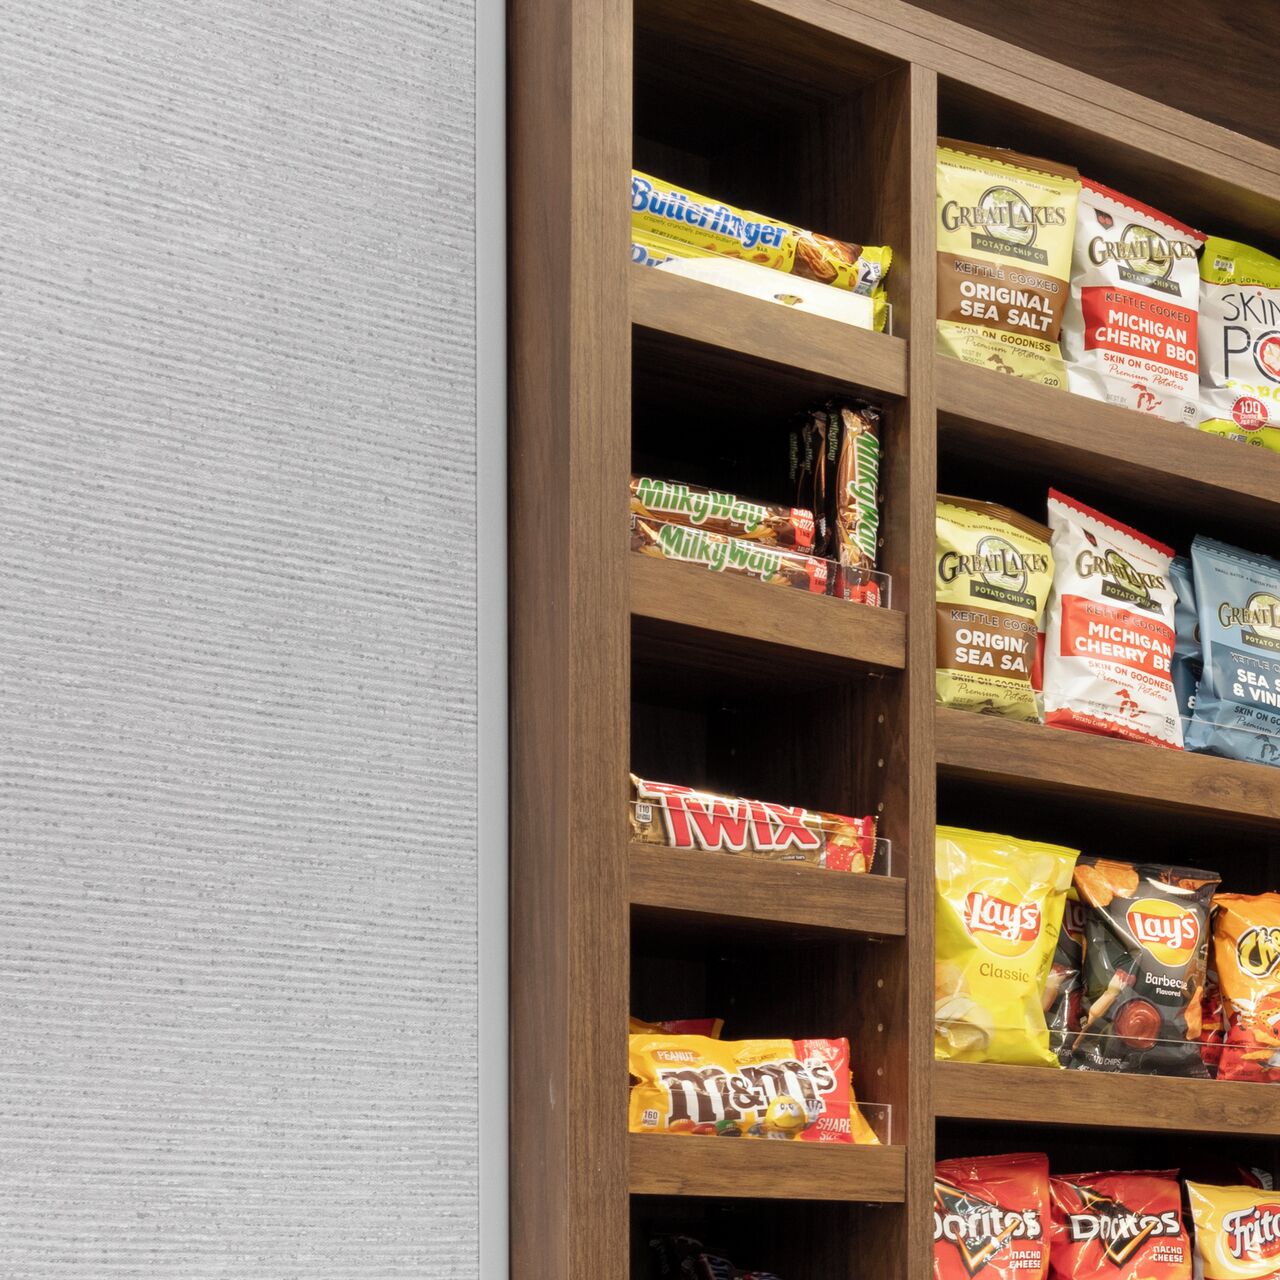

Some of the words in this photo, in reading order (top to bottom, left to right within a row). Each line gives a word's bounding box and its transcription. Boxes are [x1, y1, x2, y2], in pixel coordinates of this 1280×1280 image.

[631, 177, 788, 248] Butterfinger
[954, 260, 1005, 281] KETTLE
[1009, 272, 1059, 294] COOKED
[959, 280, 1054, 316] ORIGINAL
[1105, 292, 1147, 311] KETTLE
[1149, 303, 1192, 324] COOKED
[959, 299, 1000, 322] SEA
[1006, 308, 1053, 333] SALT
[1107, 309, 1188, 345] MICHIGAN
[1094, 326, 1161, 354] CHERRY
[1165, 343, 1198, 367] BBQ
[1103, 353, 1126, 366] SKIN
[1127, 358, 1142, 369] ON
[1144, 362, 1190, 382] GOODNESS
[1043, 376, 1059, 388] 220
[1182, 405, 1197, 416] 220
[1239, 400, 1262, 415] 100
[1087, 620, 1172, 657] MICHIGAN
[1235, 667, 1270, 690] SEA
[1232, 683, 1246, 698] &
[1233, 705, 1254, 718] SKIN
[1255, 711, 1270, 723] ON
[637, 803, 650, 815] 110
[640, 781, 821, 850] TWIX
[969, 891, 1042, 946] Lay's
[1133, 911, 1197, 949] Lay's
[978, 962, 1031, 983] Classic
[1144, 971, 1189, 991] Barbecue
[1155, 986, 1182, 998] Flavored
[656, 1050, 694, 1062] PEANUT
[644, 1109, 658, 1120] 160
[1070, 1210, 1182, 1242] Doritos
[1010, 1259, 1042, 1270] CHEESE
[1011, 1250, 1042, 1260] NACHO
[1152, 1253, 1184, 1264] CHEESE
